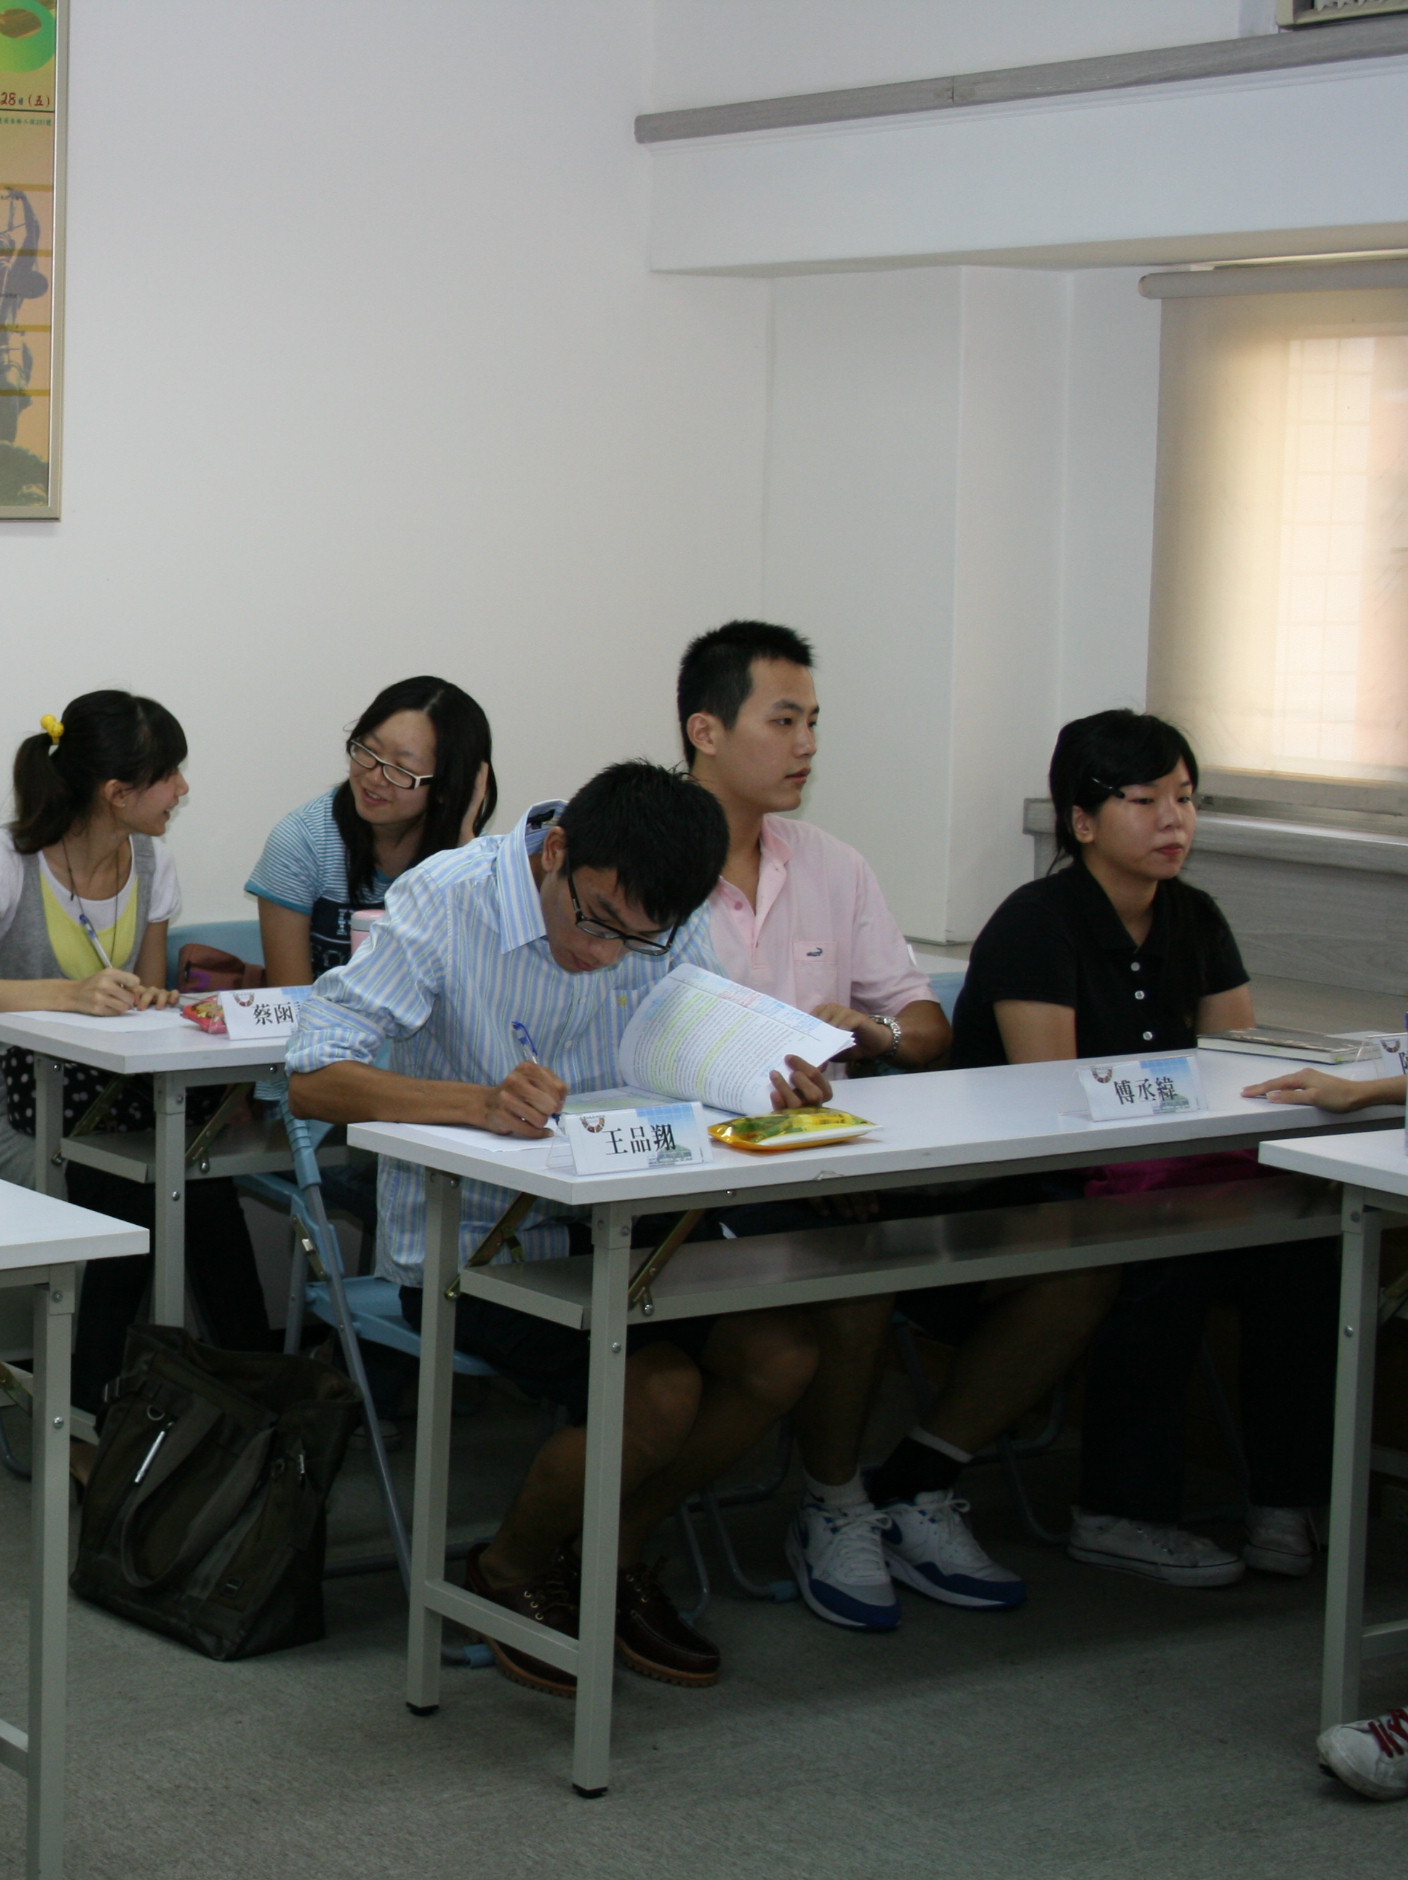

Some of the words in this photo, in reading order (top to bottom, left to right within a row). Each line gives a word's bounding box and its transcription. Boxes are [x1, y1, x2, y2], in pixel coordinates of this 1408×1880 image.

[253, 1001, 302, 1026] 蔡函
[1113, 1075, 1179, 1105] 傅丞緯
[602, 1123, 677, 1156] 王品翔
